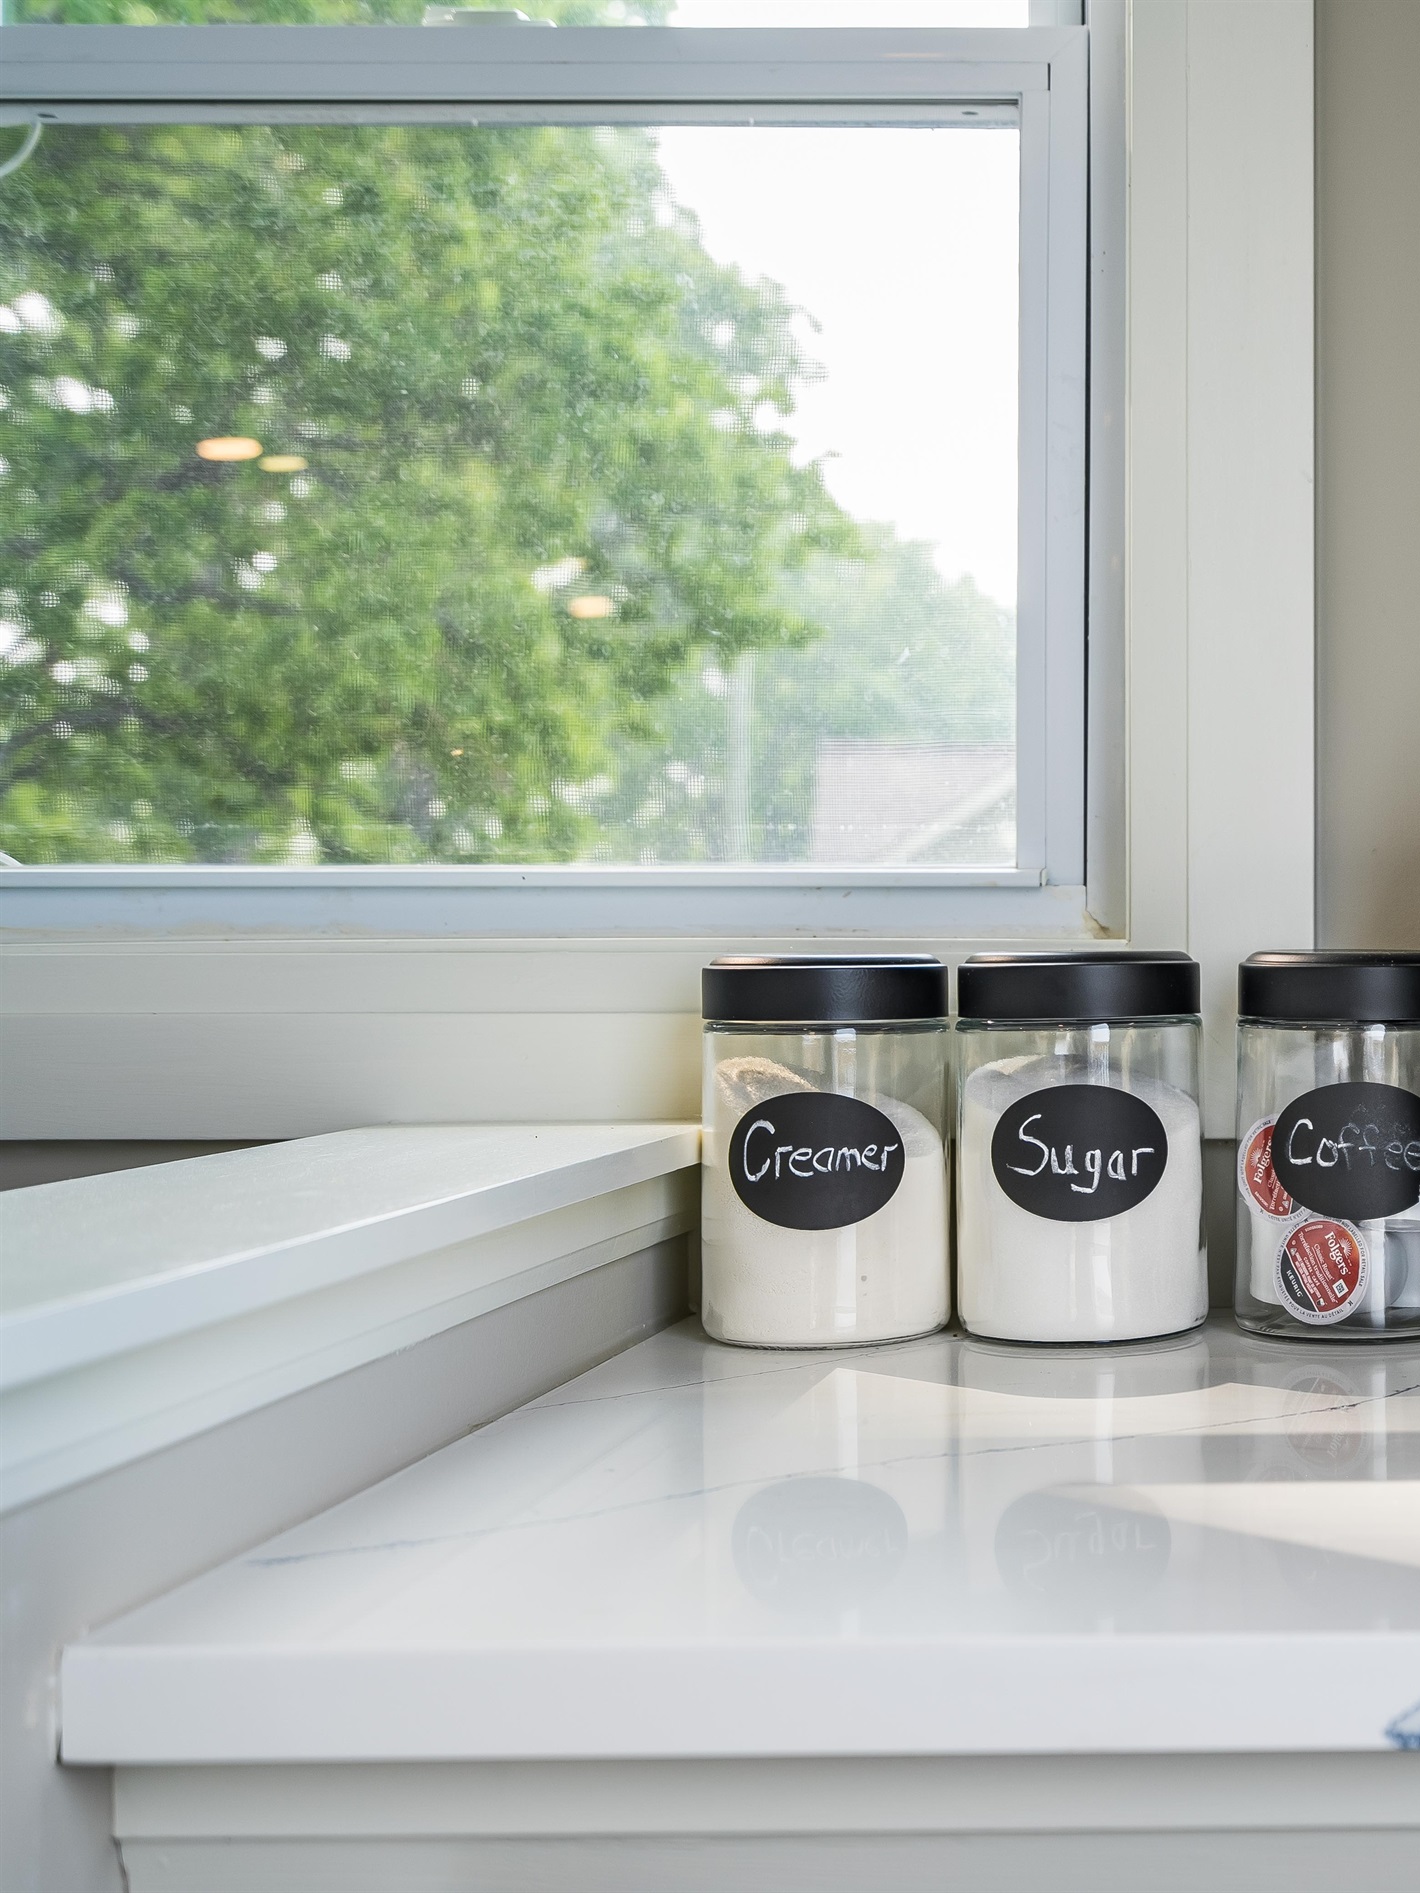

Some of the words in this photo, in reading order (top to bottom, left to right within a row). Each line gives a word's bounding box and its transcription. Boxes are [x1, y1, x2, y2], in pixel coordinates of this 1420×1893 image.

[743, 1119, 898, 1182] Creamer
[1006, 1113, 1155, 1193] Sugar
[1313, 1243, 1326, 1264] Classic
[1321, 1263, 1334, 1281] Roast
[1324, 1231, 1350, 1276] Folgers
[1285, 1269, 1303, 1298] KEURIG
